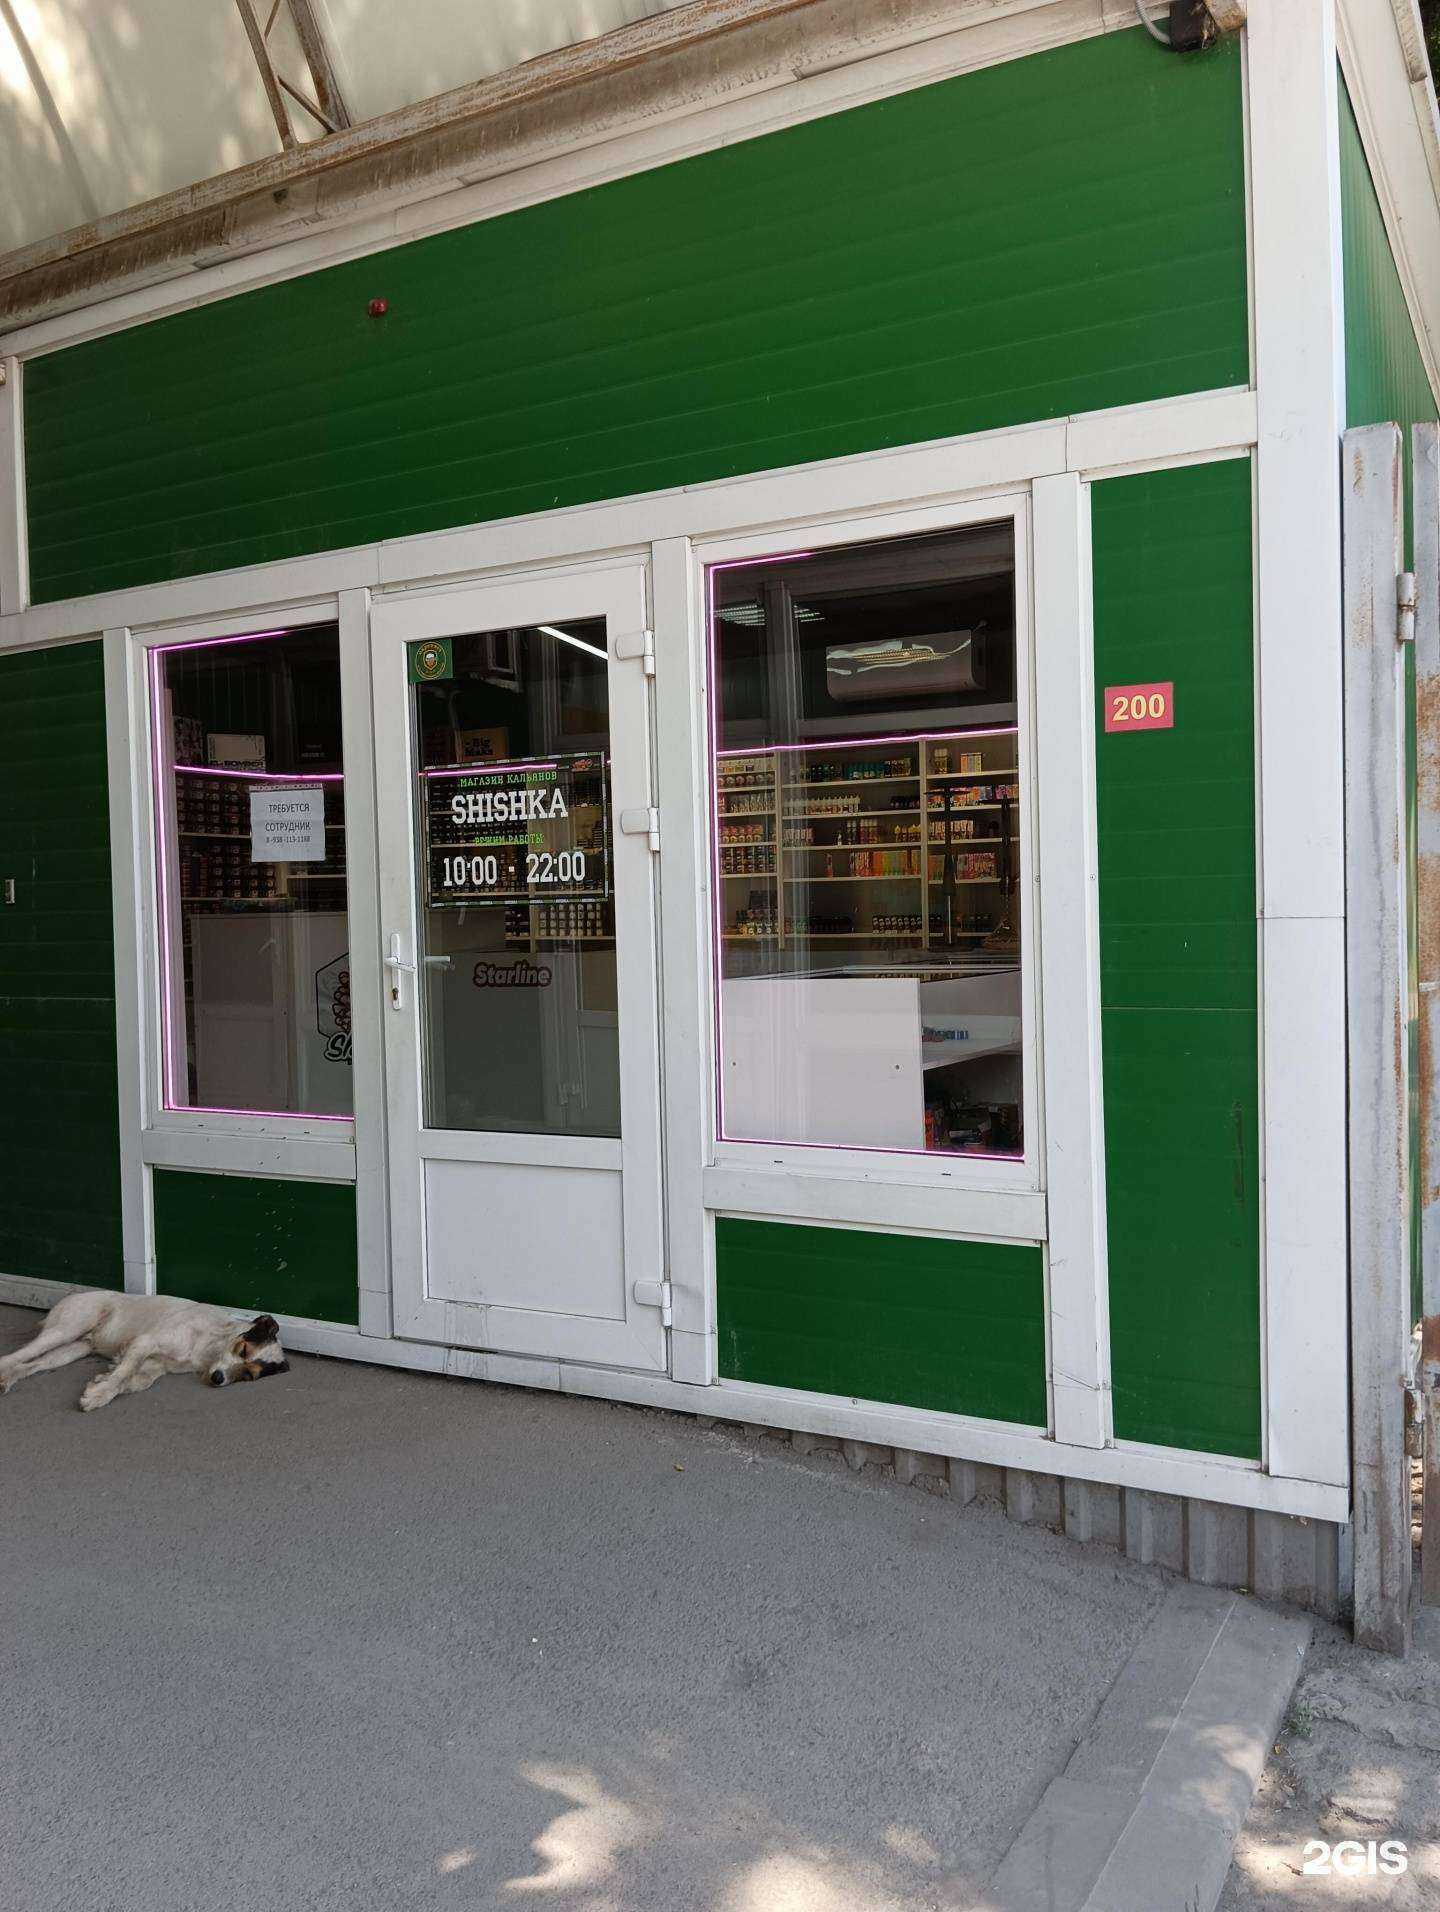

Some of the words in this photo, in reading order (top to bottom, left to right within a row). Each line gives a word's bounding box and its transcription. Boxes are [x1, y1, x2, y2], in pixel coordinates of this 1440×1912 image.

[1112, 693, 1165, 722] 200
[460, 775, 504, 787] МАГАЗИН
[507, 771, 558, 784] КАЛЬЯНОВ
[268, 803, 310, 813] ТРЕБУЕТСЯ
[451, 788, 569, 824] SHISHKA
[265, 822, 311, 833] СОТРУДНИК
[474, 834, 507, 845] РЕЖИМ
[508, 832, 545, 845] РАБОТЫ
[526, 850, 586, 883] 22:00
[474, 960, 552, 986] Starline
